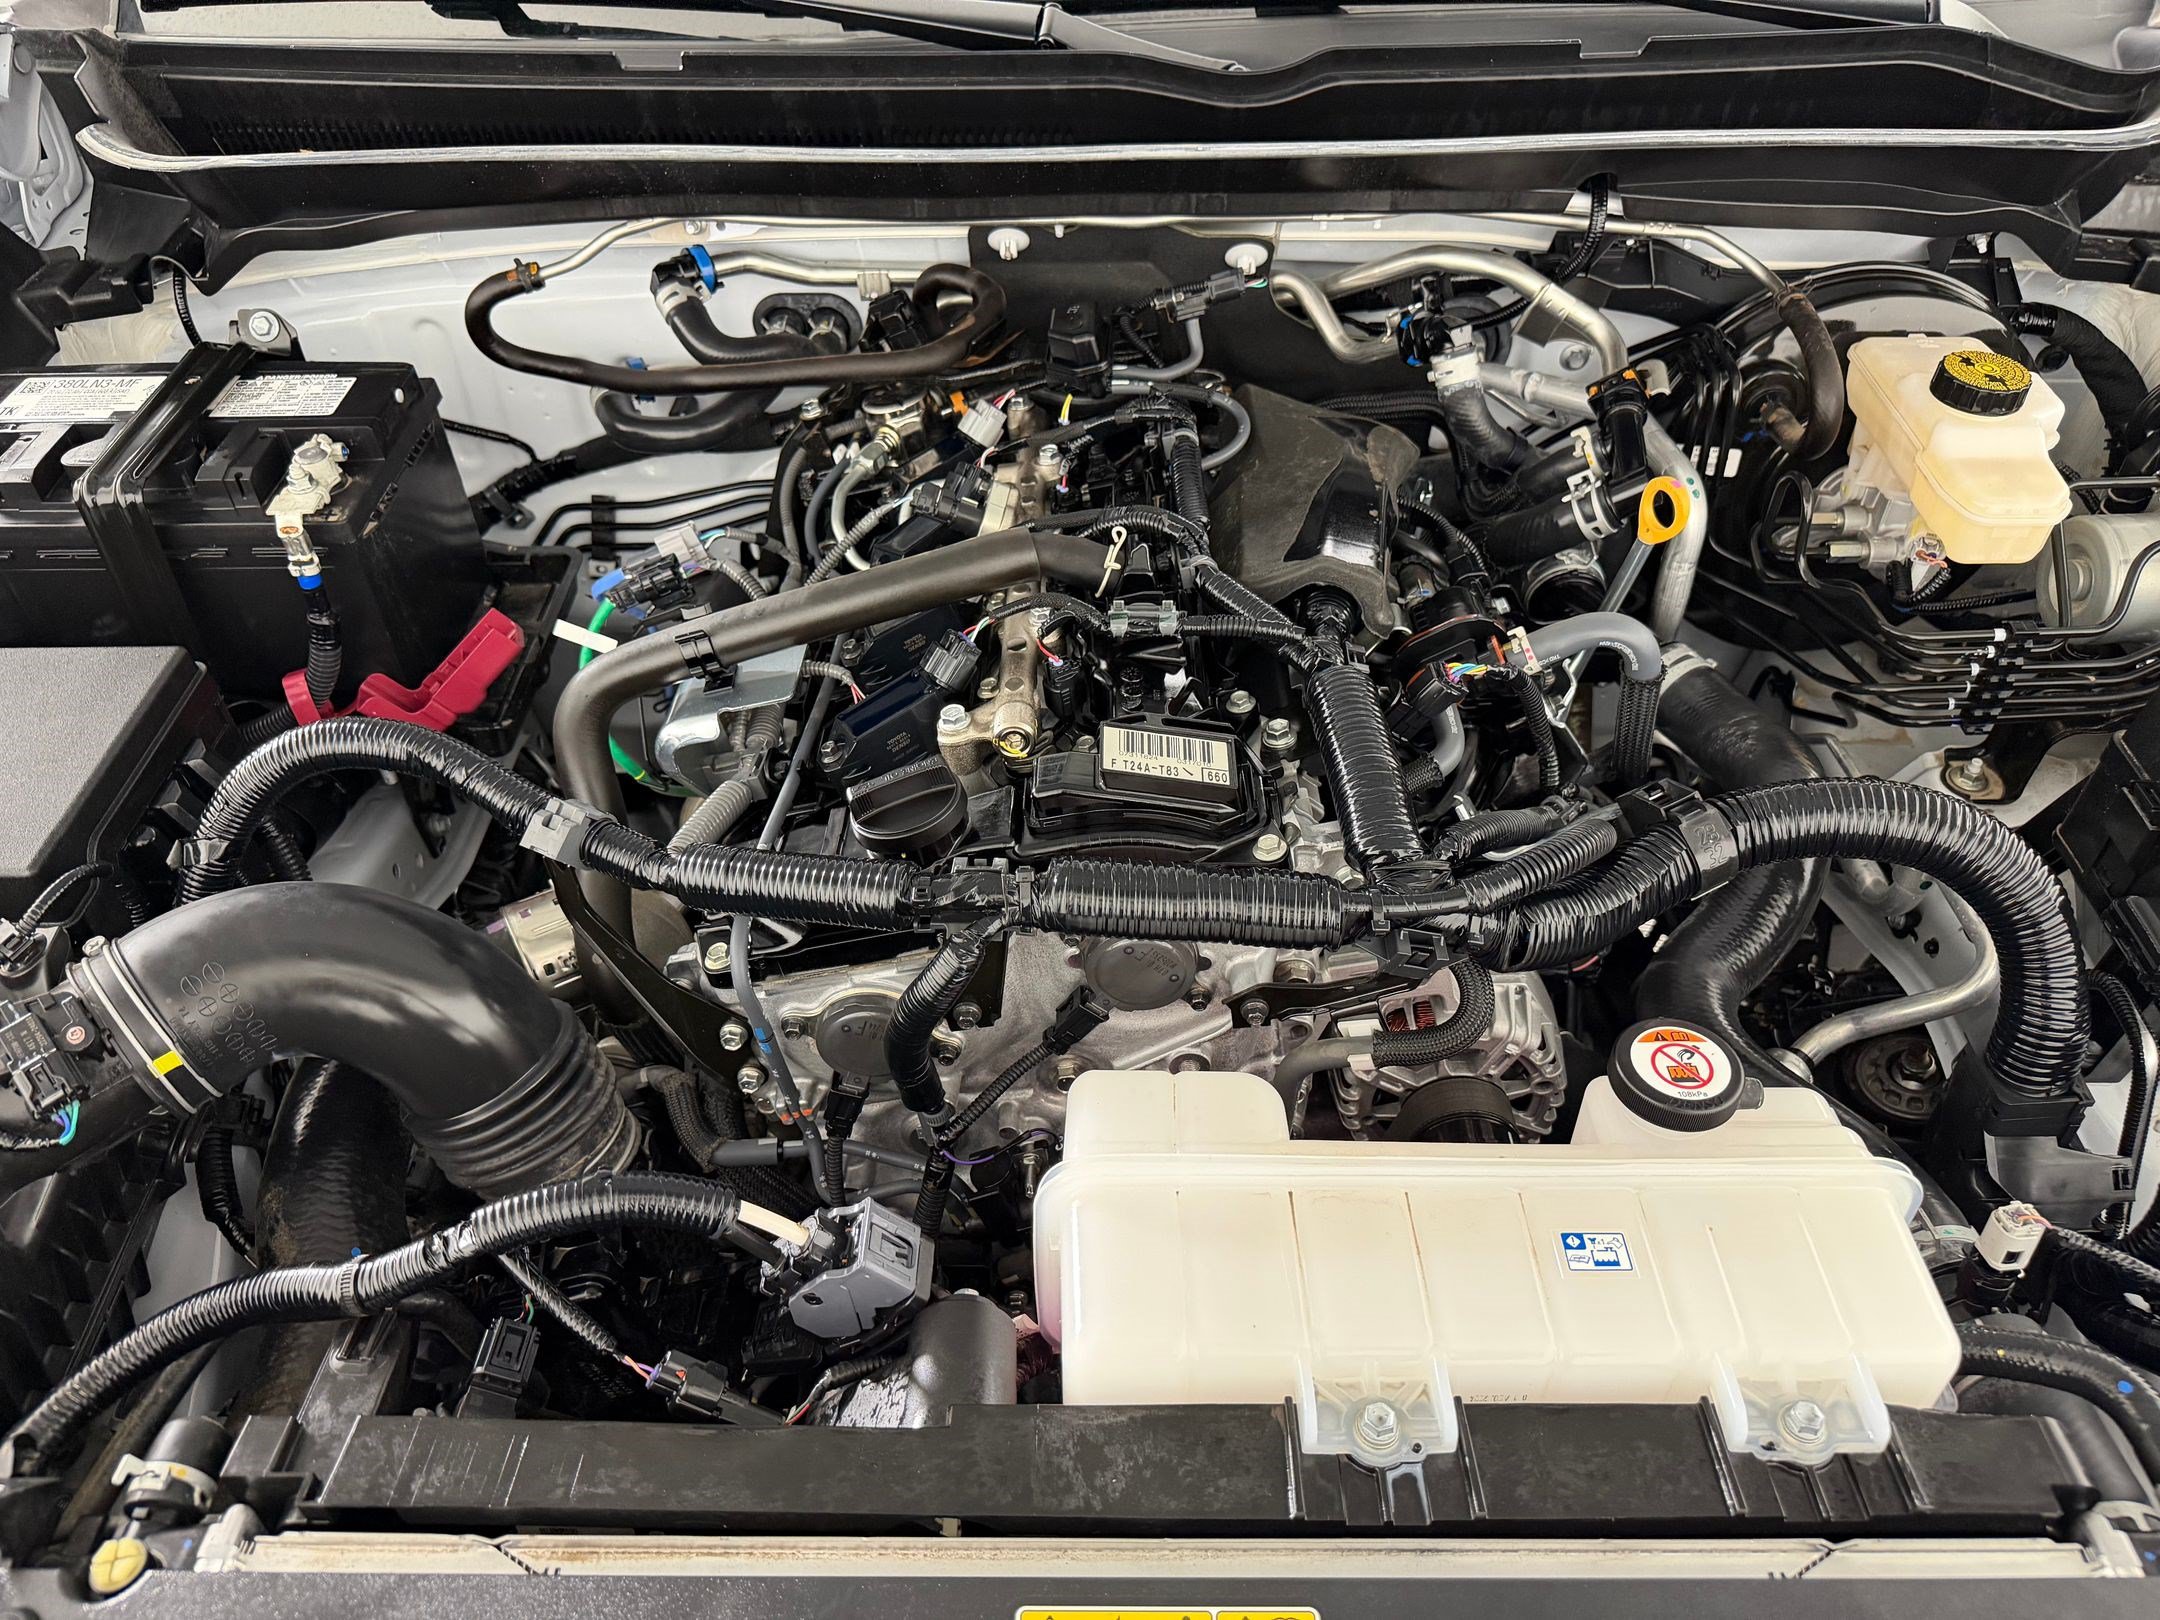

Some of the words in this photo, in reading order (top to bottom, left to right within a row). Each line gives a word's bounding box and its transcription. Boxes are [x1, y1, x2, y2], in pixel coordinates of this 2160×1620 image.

[53, 378, 142, 389] 380LN3-MF
[887, 731, 908, 745] TOYOTA
[891, 739, 911, 752] DENSO
[1111, 758, 1117, 768] F
[1123, 759, 1179, 776] T24A-T83
[1207, 771, 1228, 783] 660
[1677, 1090, 1709, 1098] 108kPa
